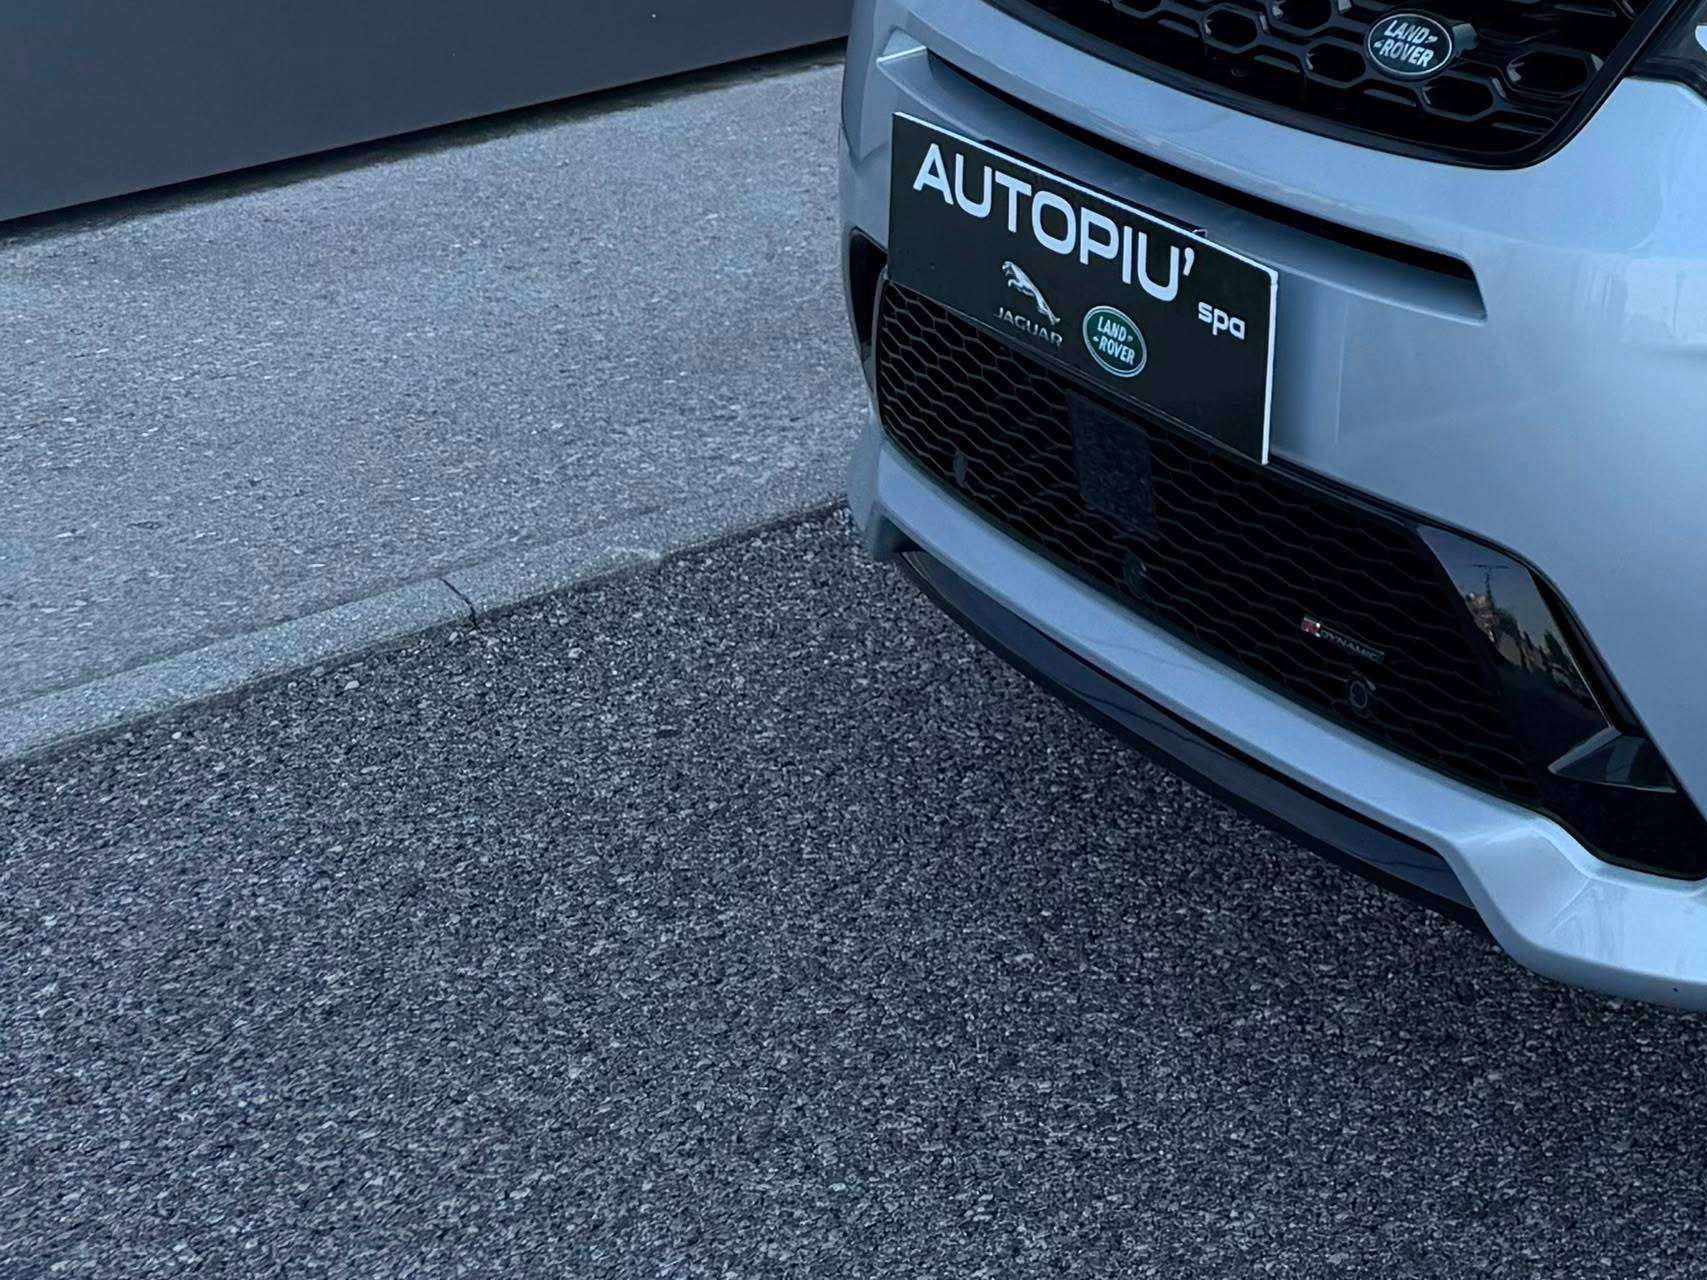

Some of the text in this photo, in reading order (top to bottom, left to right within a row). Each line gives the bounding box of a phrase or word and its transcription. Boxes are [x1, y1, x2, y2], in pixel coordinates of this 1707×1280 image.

[1384, 20, 1431, 44] LAND
[1380, 39, 1434, 68] ROVER
[913, 142, 1196, 302] AUTOPIU'
[994, 307, 1063, 347] JAGUAR
[1097, 316, 1127, 342] LAND
[1198, 301, 1246, 340] spa
[1099, 339, 1136, 366] ROVER
